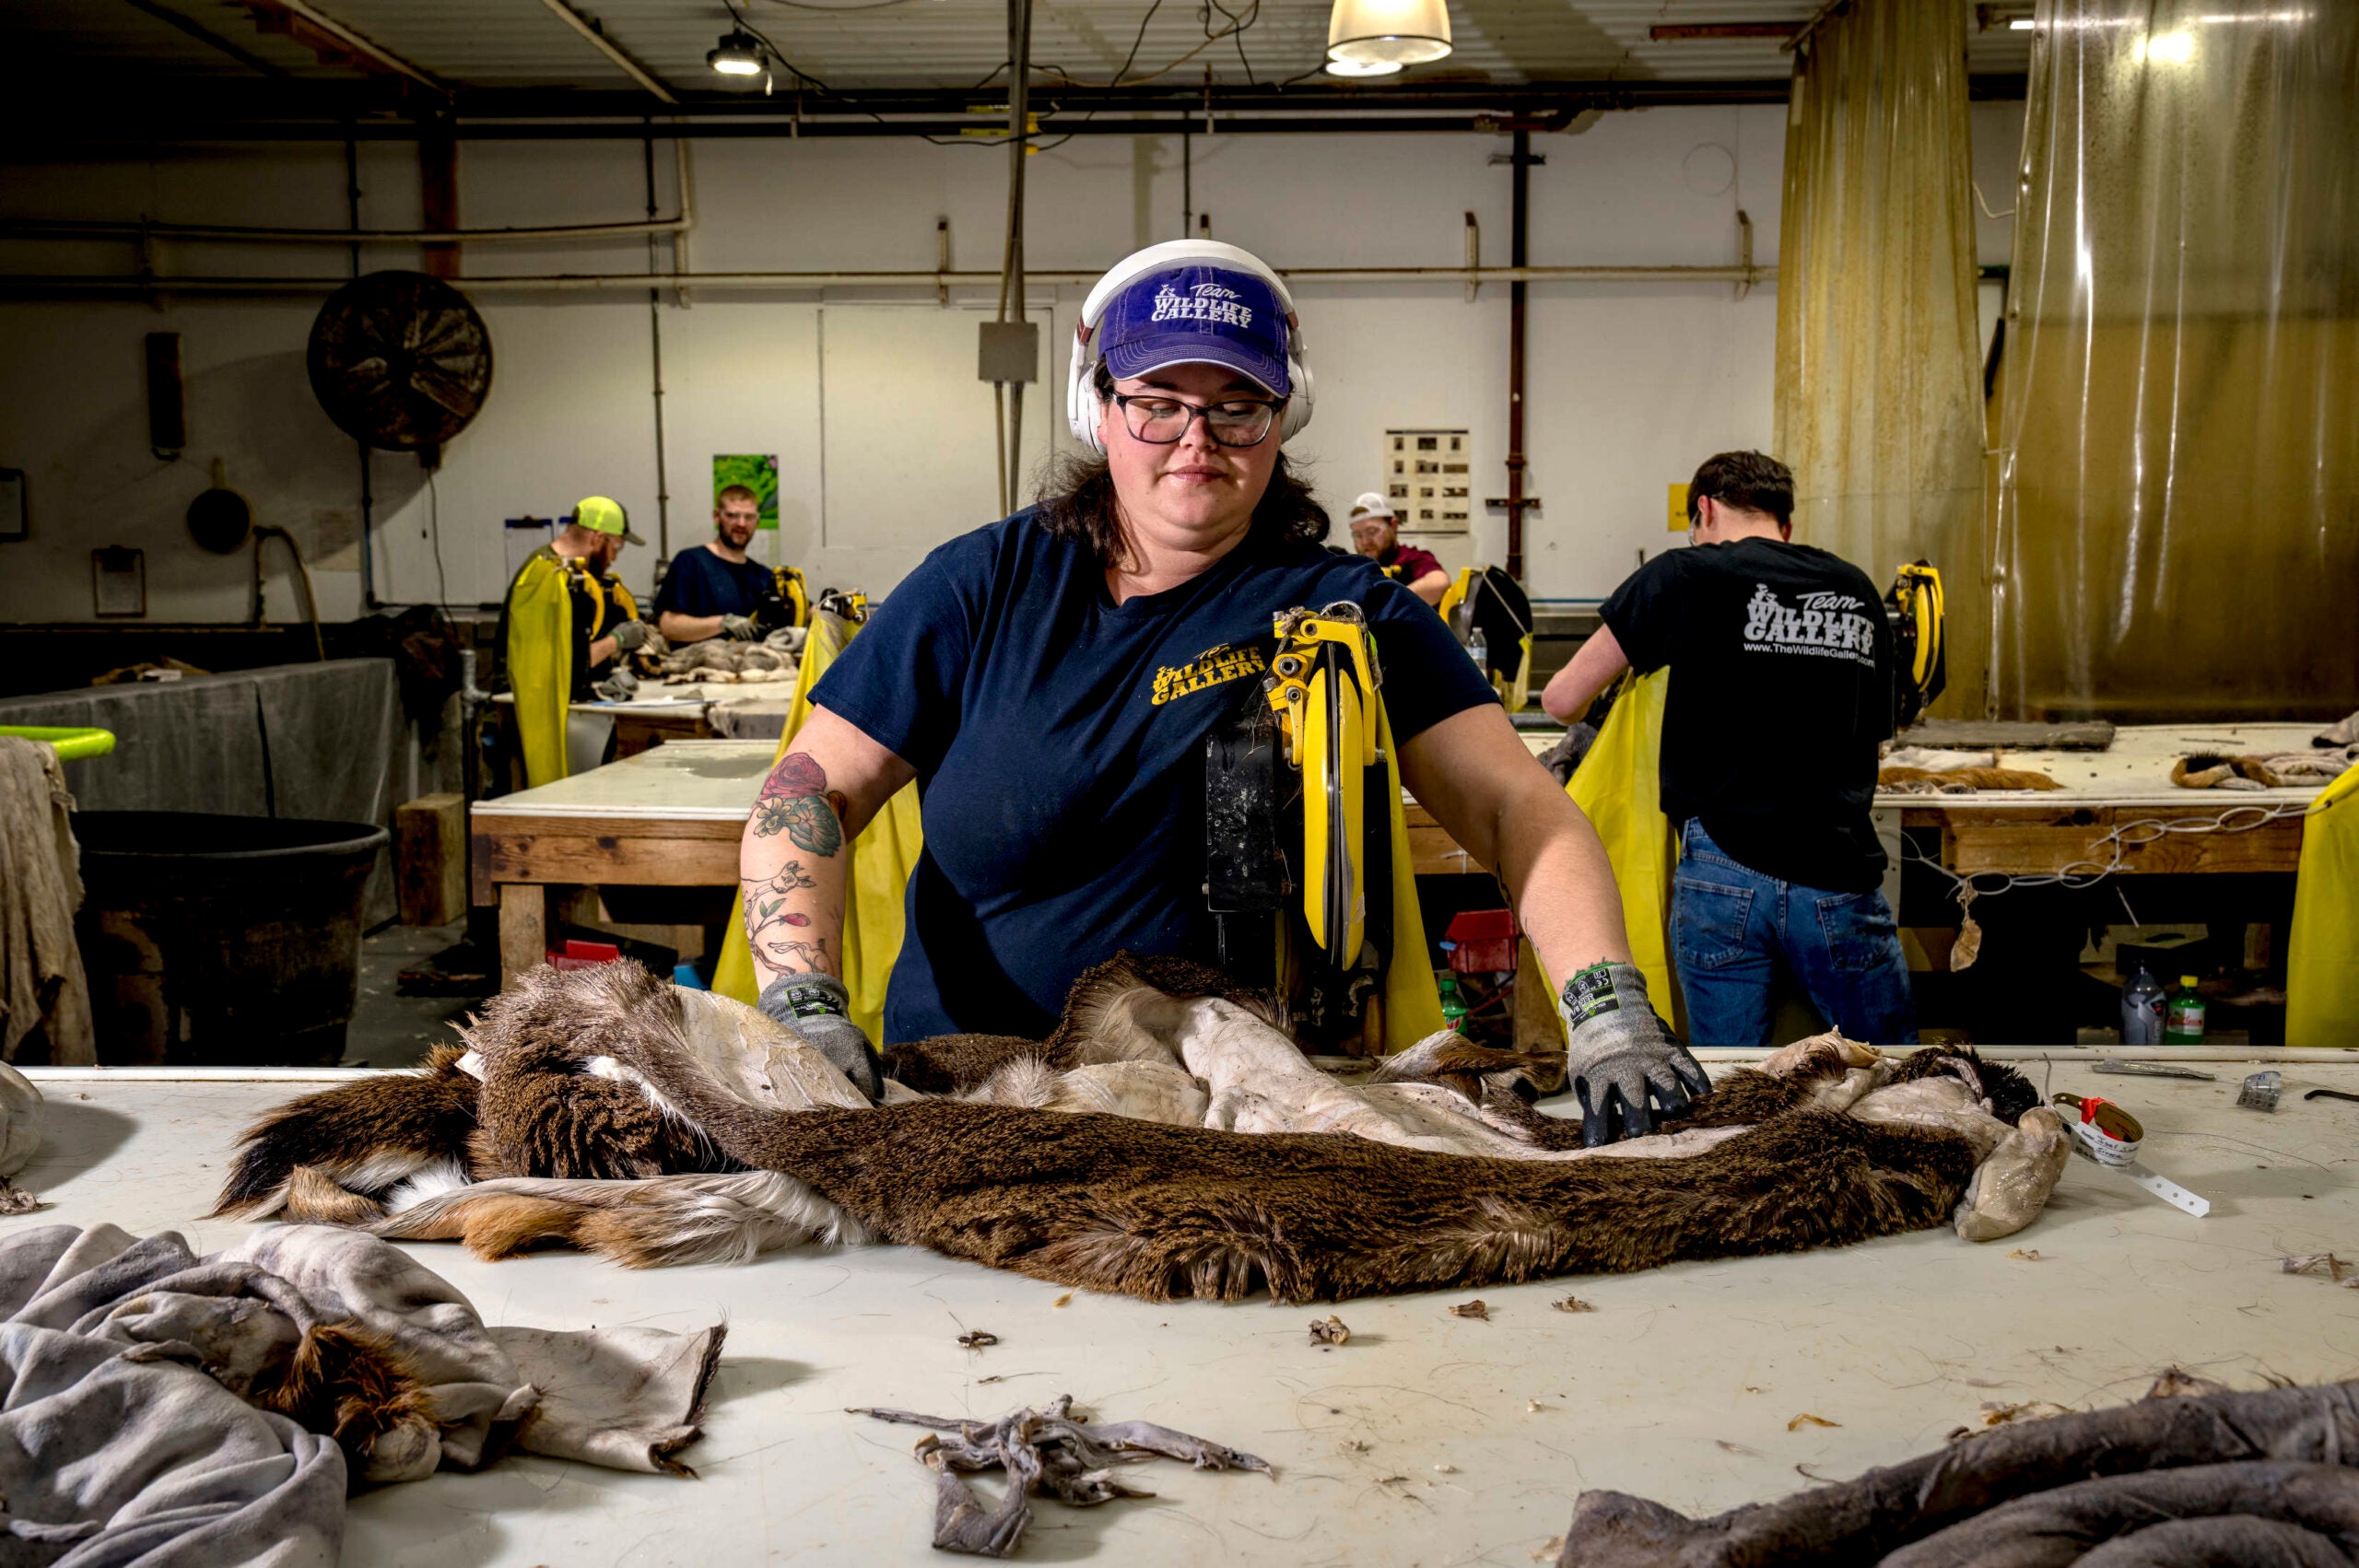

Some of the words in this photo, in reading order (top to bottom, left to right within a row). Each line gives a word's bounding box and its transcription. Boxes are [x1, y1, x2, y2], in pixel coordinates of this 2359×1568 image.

[1190, 283, 1242, 299] Team
[1154, 297, 1252, 318] WILDLIFE
[1151, 308, 1252, 329] GALLERY
[1796, 591, 1865, 610] Team
[1747, 603, 1875, 634] WILDLIFE
[1743, 621, 1874, 655] GALLERY
[1151, 659, 1266, 706] GALLERY
